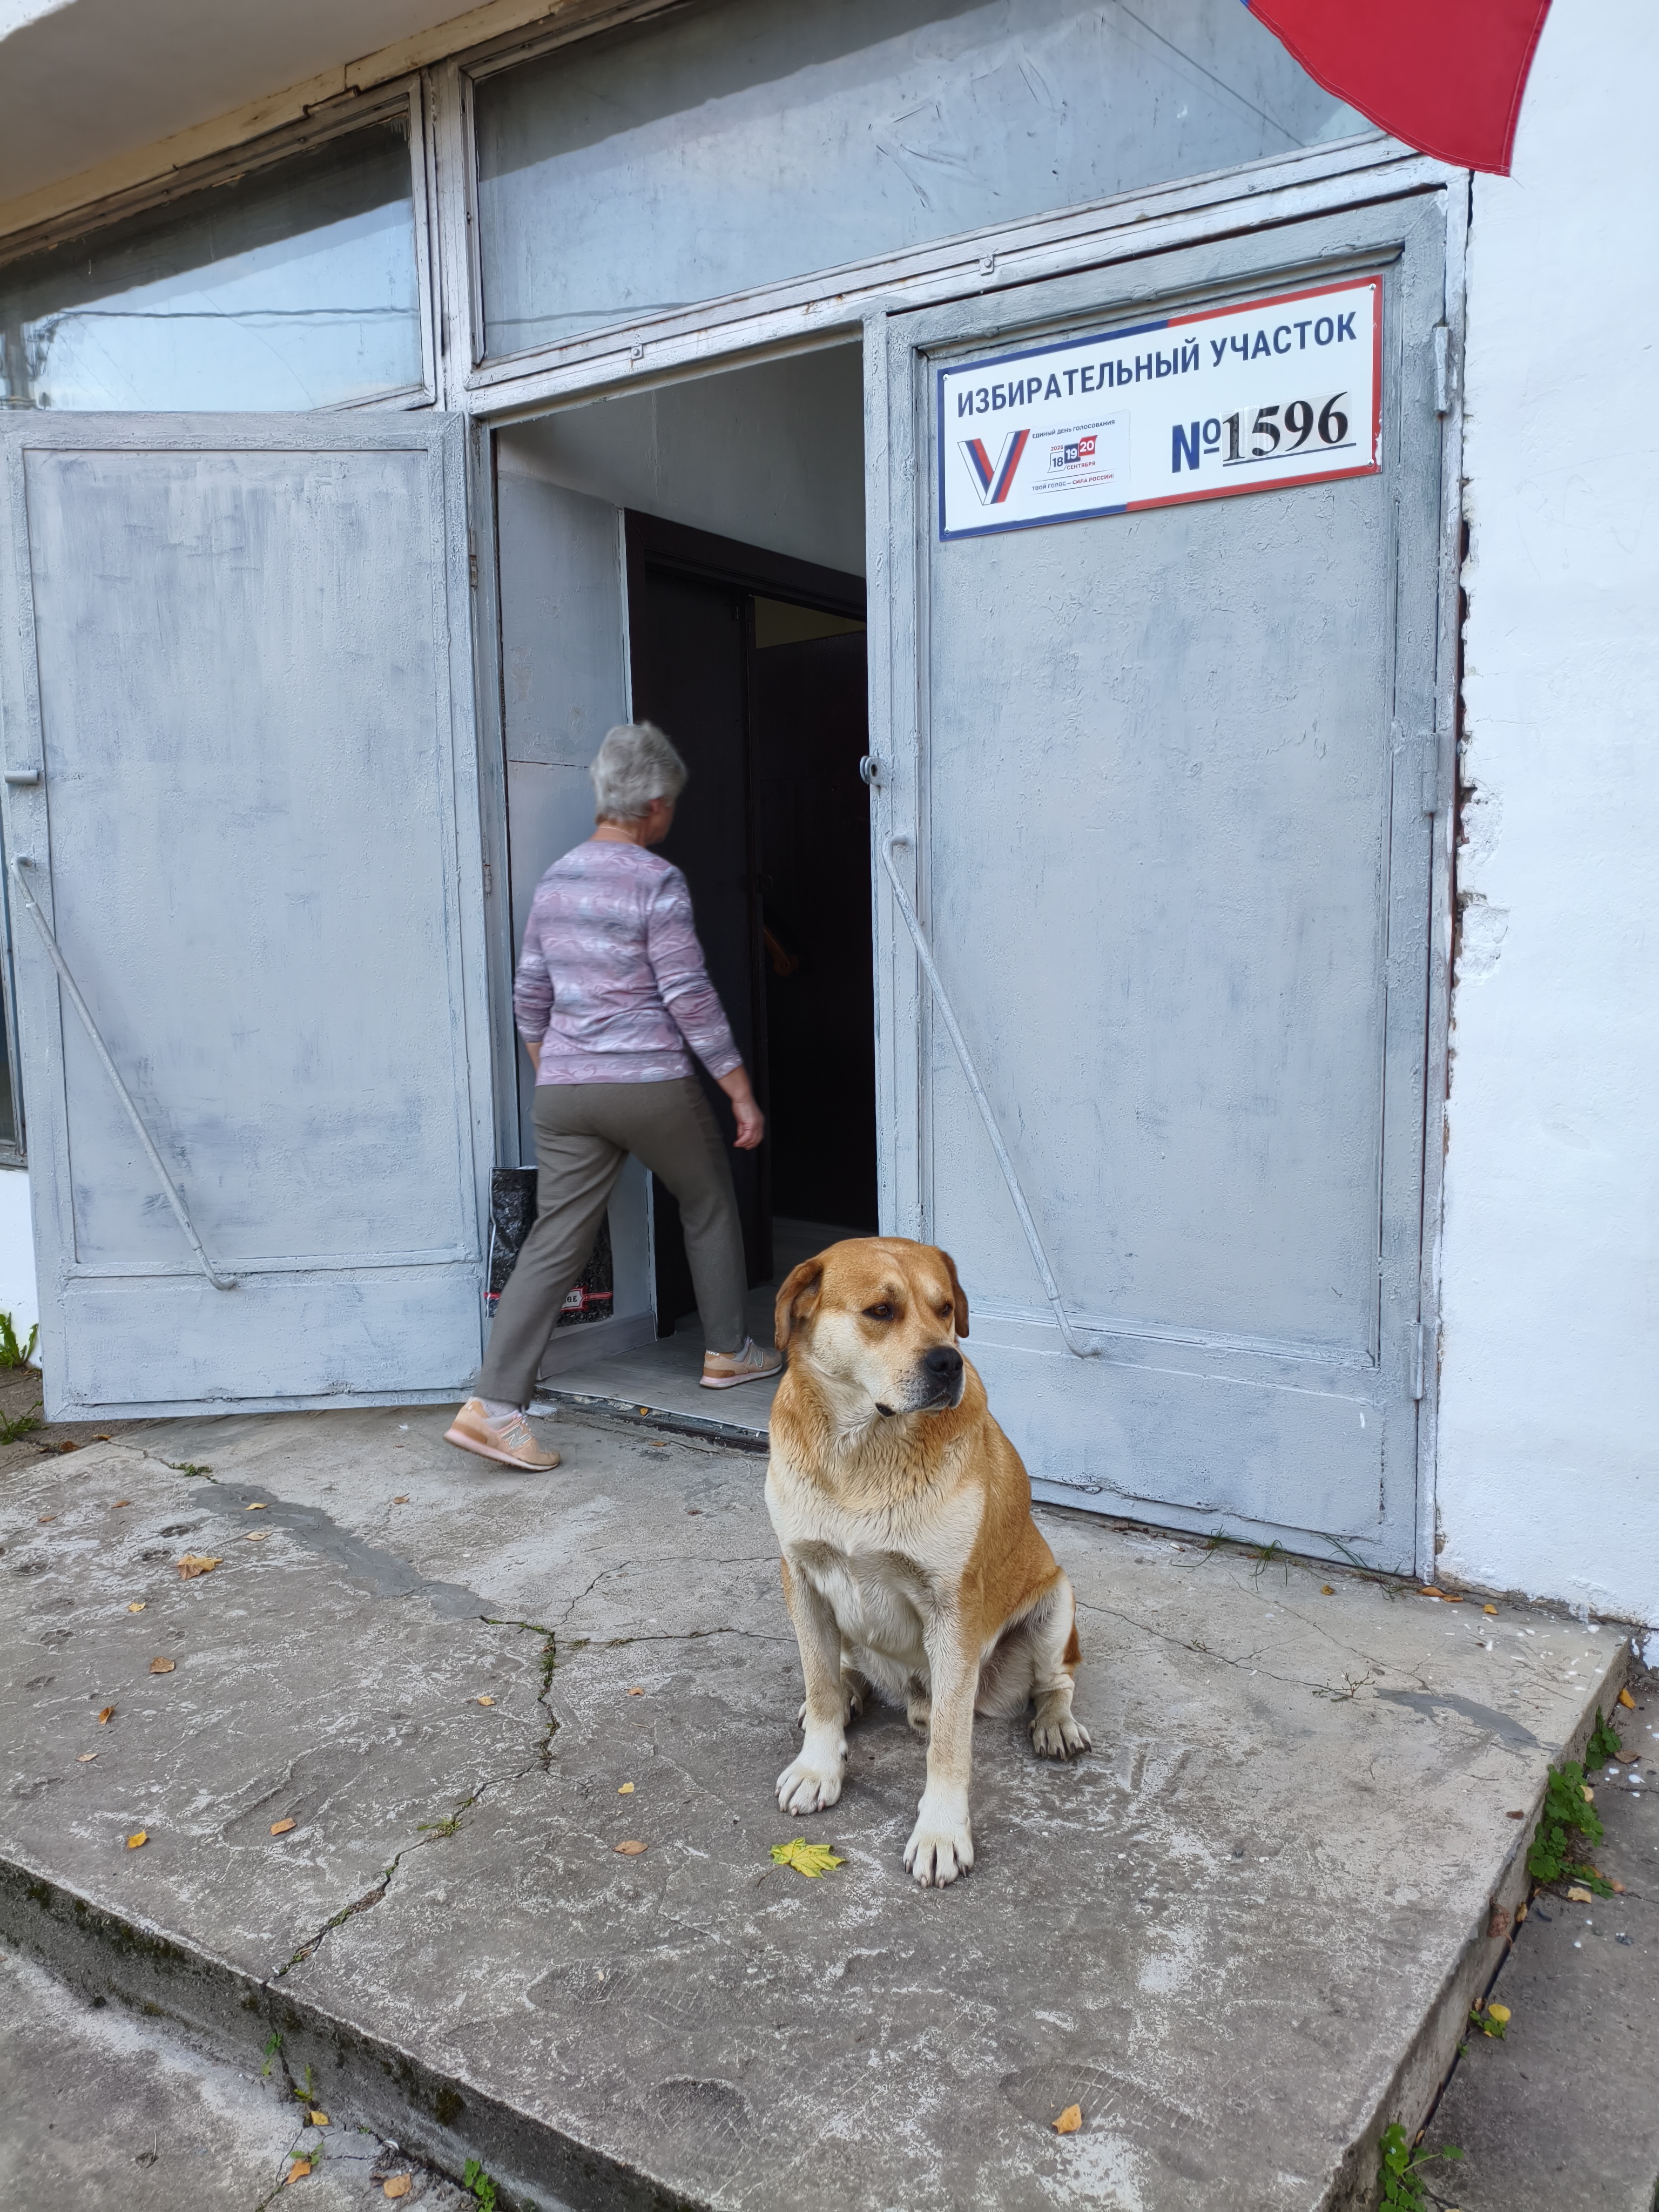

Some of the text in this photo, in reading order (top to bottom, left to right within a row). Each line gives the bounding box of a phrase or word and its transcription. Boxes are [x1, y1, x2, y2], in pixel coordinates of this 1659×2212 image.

[957, 311, 1357, 418] ИЗБИРАТЕЛЬНЫЙ УЧАСТОК
[1032, 420, 1115, 439] ЕДИНЫЙ ДЕНЬ ГОЛОСОВАНИЯ
[1052, 440, 1095, 468] 18 19 20
[1067, 461, 1096, 470] СЕНТЯБРЯ
[1089, 473, 1114, 482] РОССИИ!
